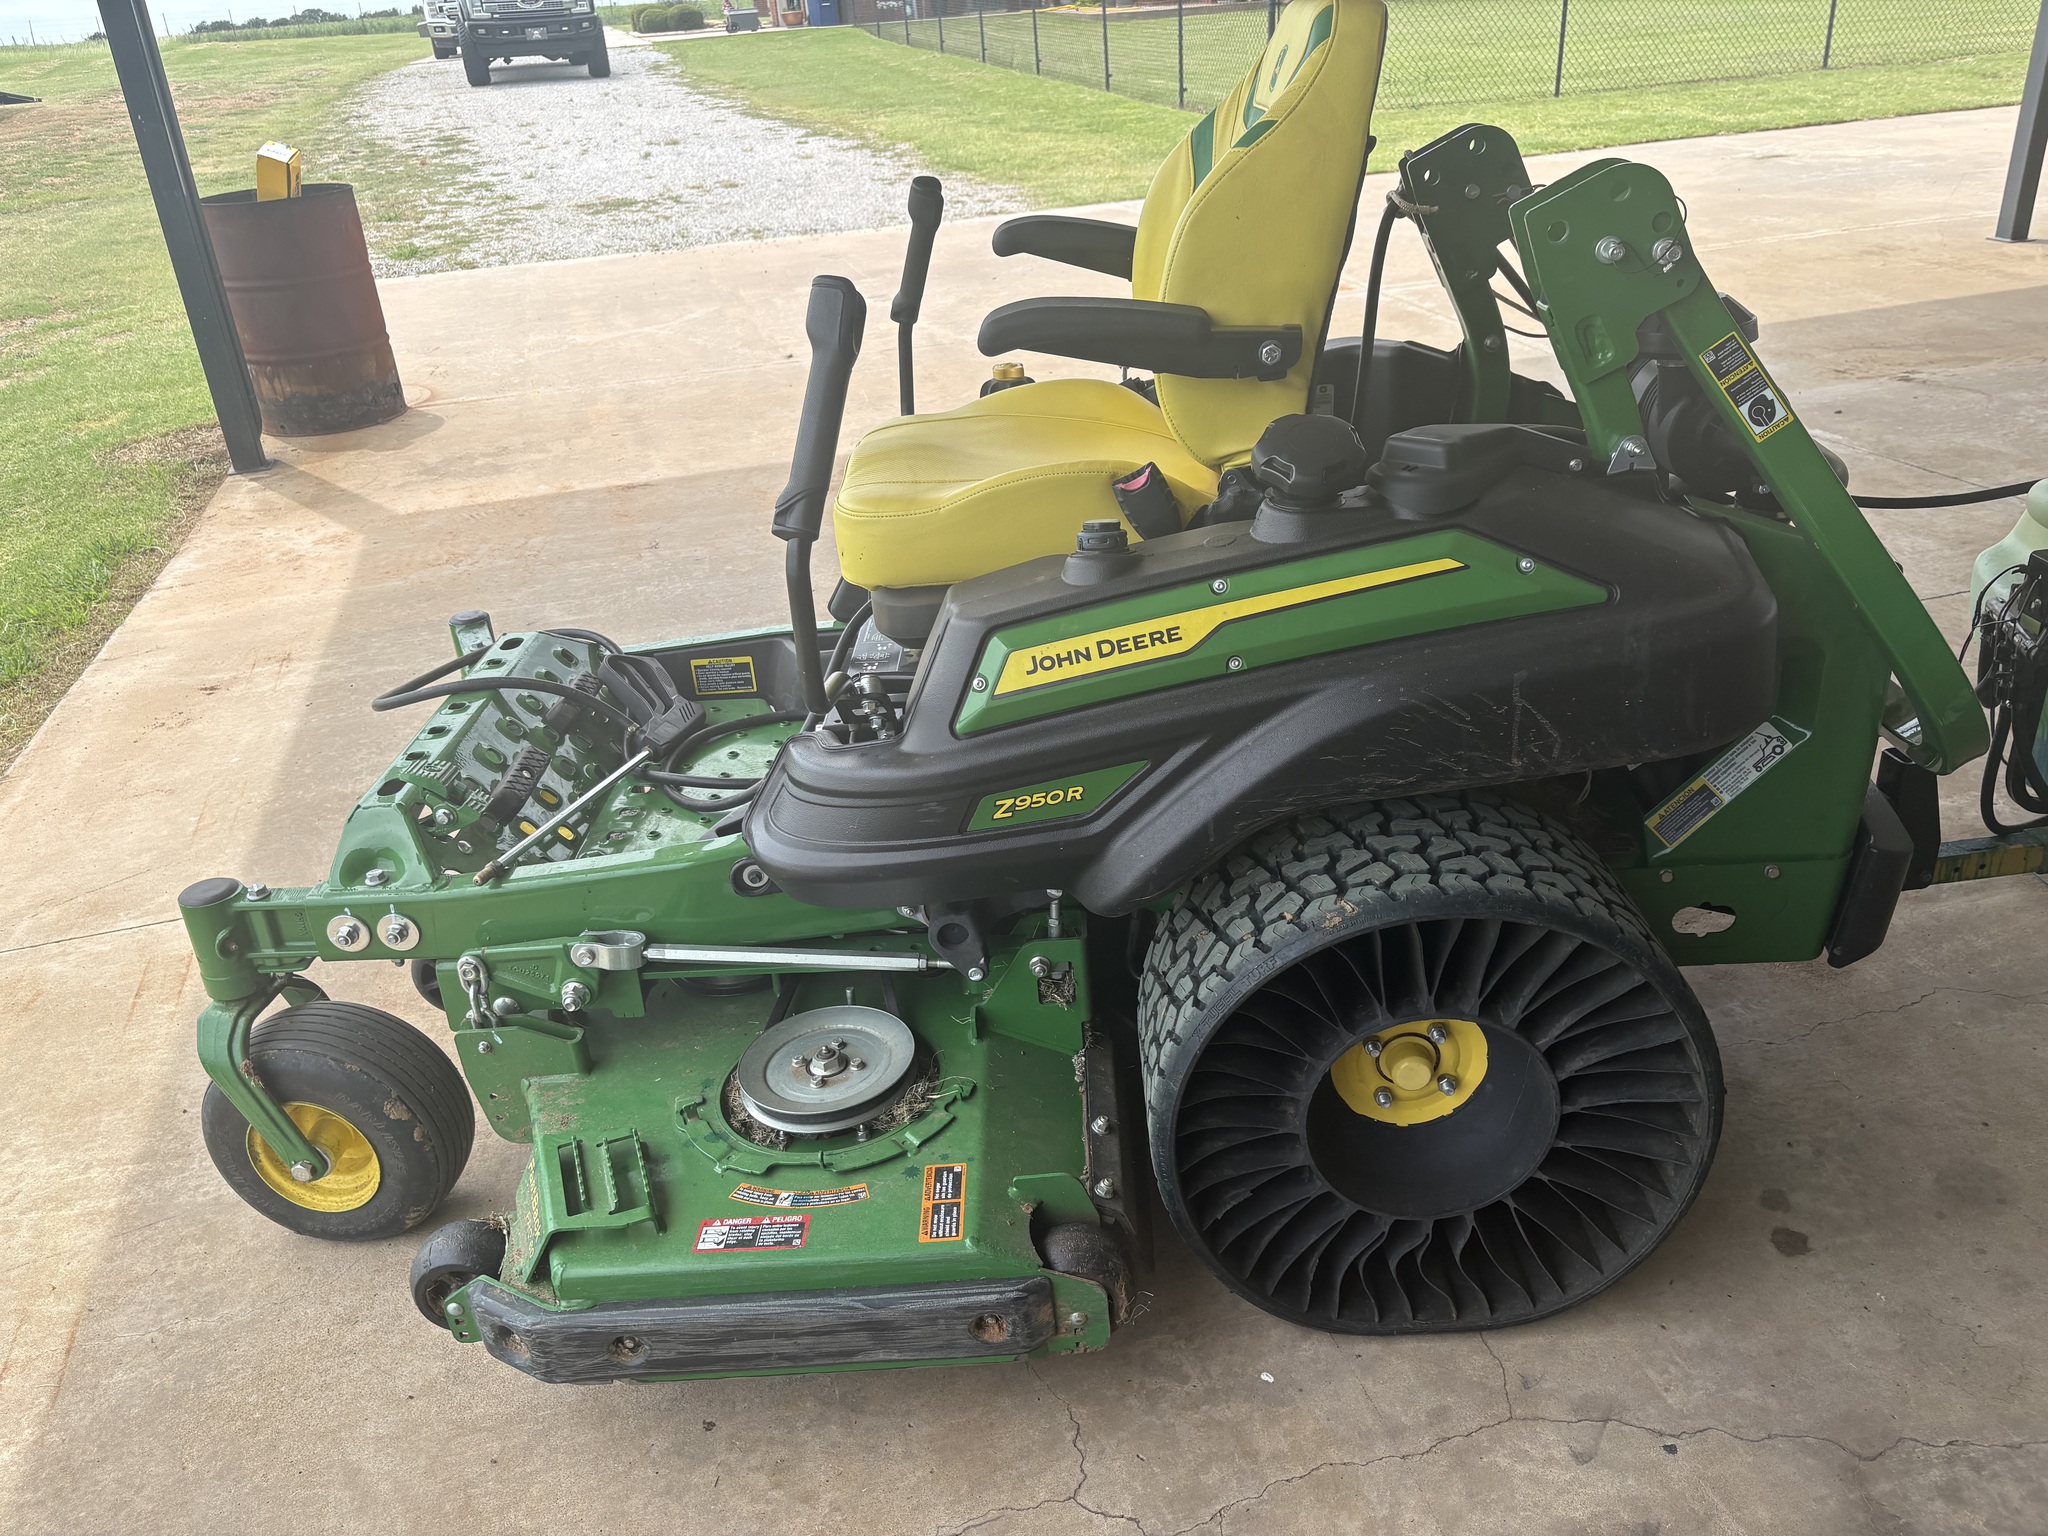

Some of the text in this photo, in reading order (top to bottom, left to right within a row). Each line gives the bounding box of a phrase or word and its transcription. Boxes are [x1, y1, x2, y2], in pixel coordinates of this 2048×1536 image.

[1758, 421, 1785, 440] CAUTION
[1026, 626, 1183, 676] JOHN DEERE
[992, 785, 1084, 821] Z950R
[1664, 788, 1695, 814] ATENCIÓN
[1241, 956, 1278, 988] TURF
[924, 1167, 933, 1197] ADVERTENCIA
[922, 1207, 930, 1230] WARNING
